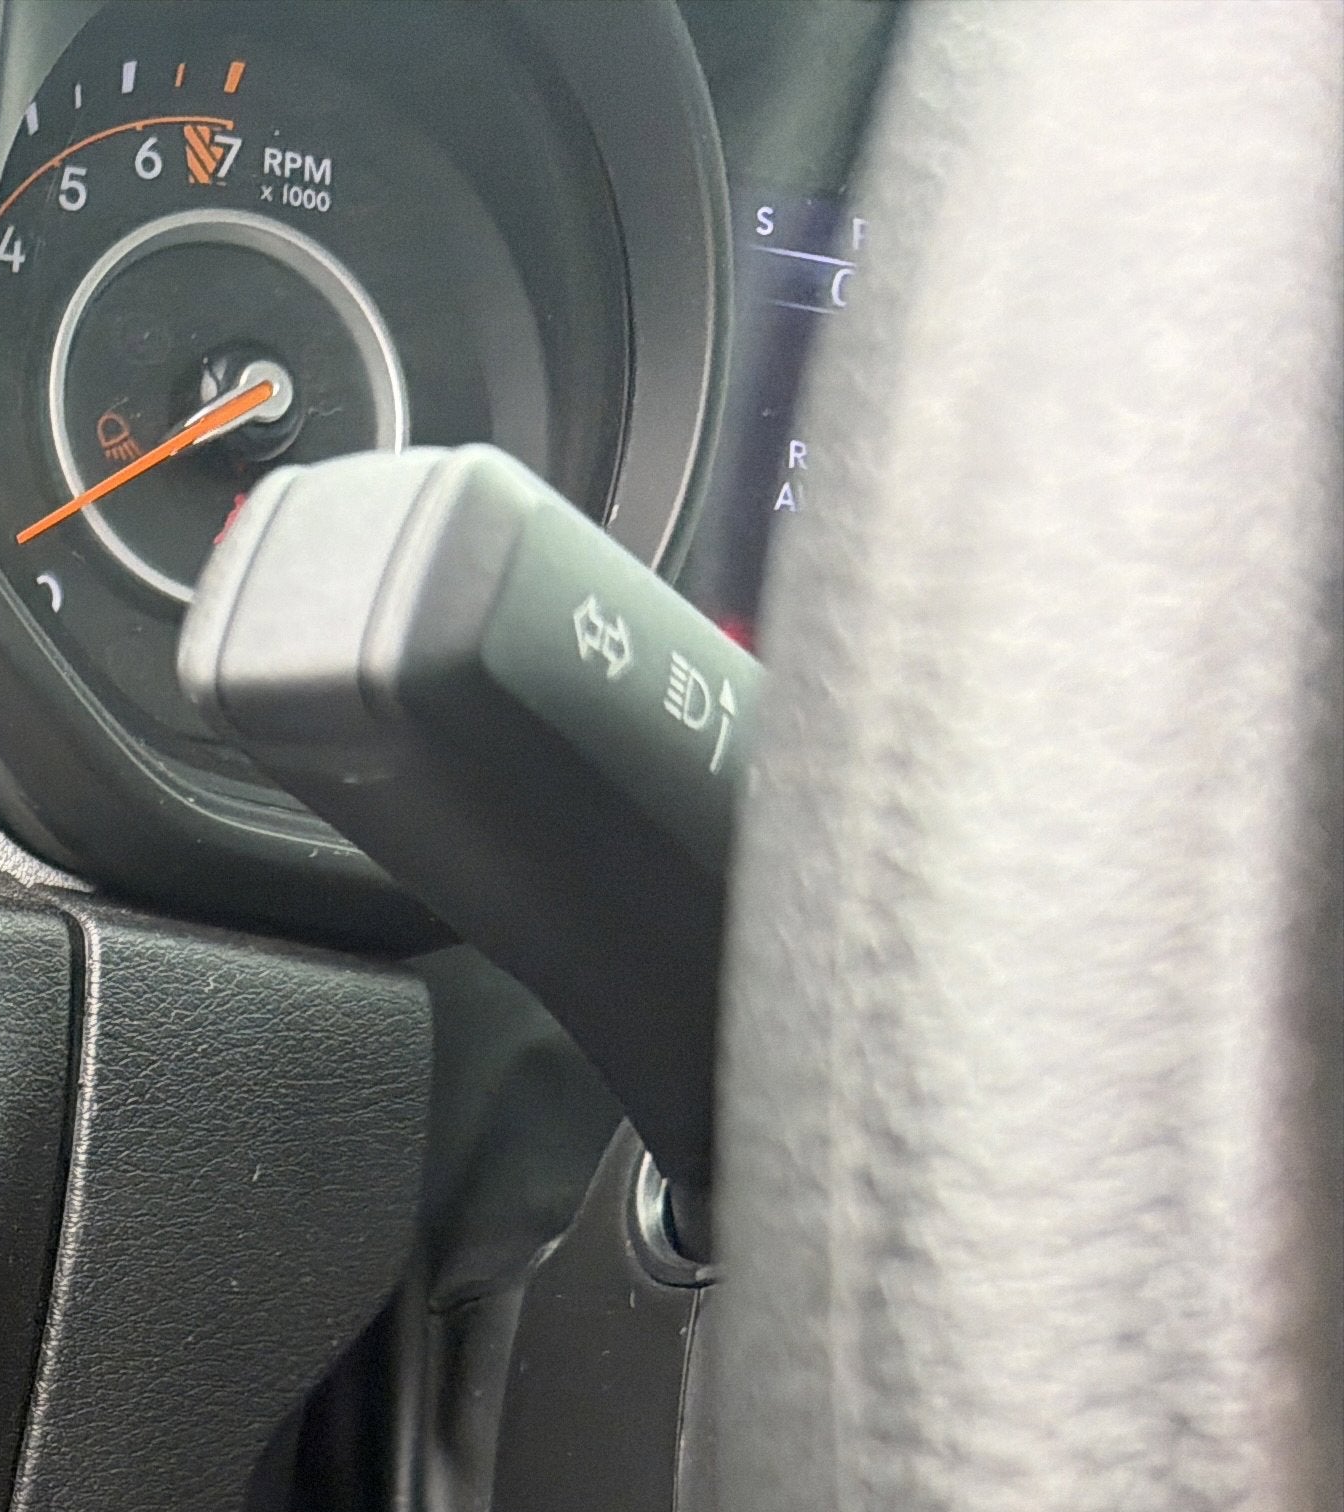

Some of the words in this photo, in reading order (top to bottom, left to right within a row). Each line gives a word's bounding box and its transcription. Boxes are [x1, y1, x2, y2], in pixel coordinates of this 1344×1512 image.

[134, 136, 163, 181] 6
[214, 134, 243, 179] 7
[263, 146, 333, 186] RPM
[58, 166, 88, 211] 5
[282, 184, 332, 213] 1000
[755, 206, 775, 236] S
